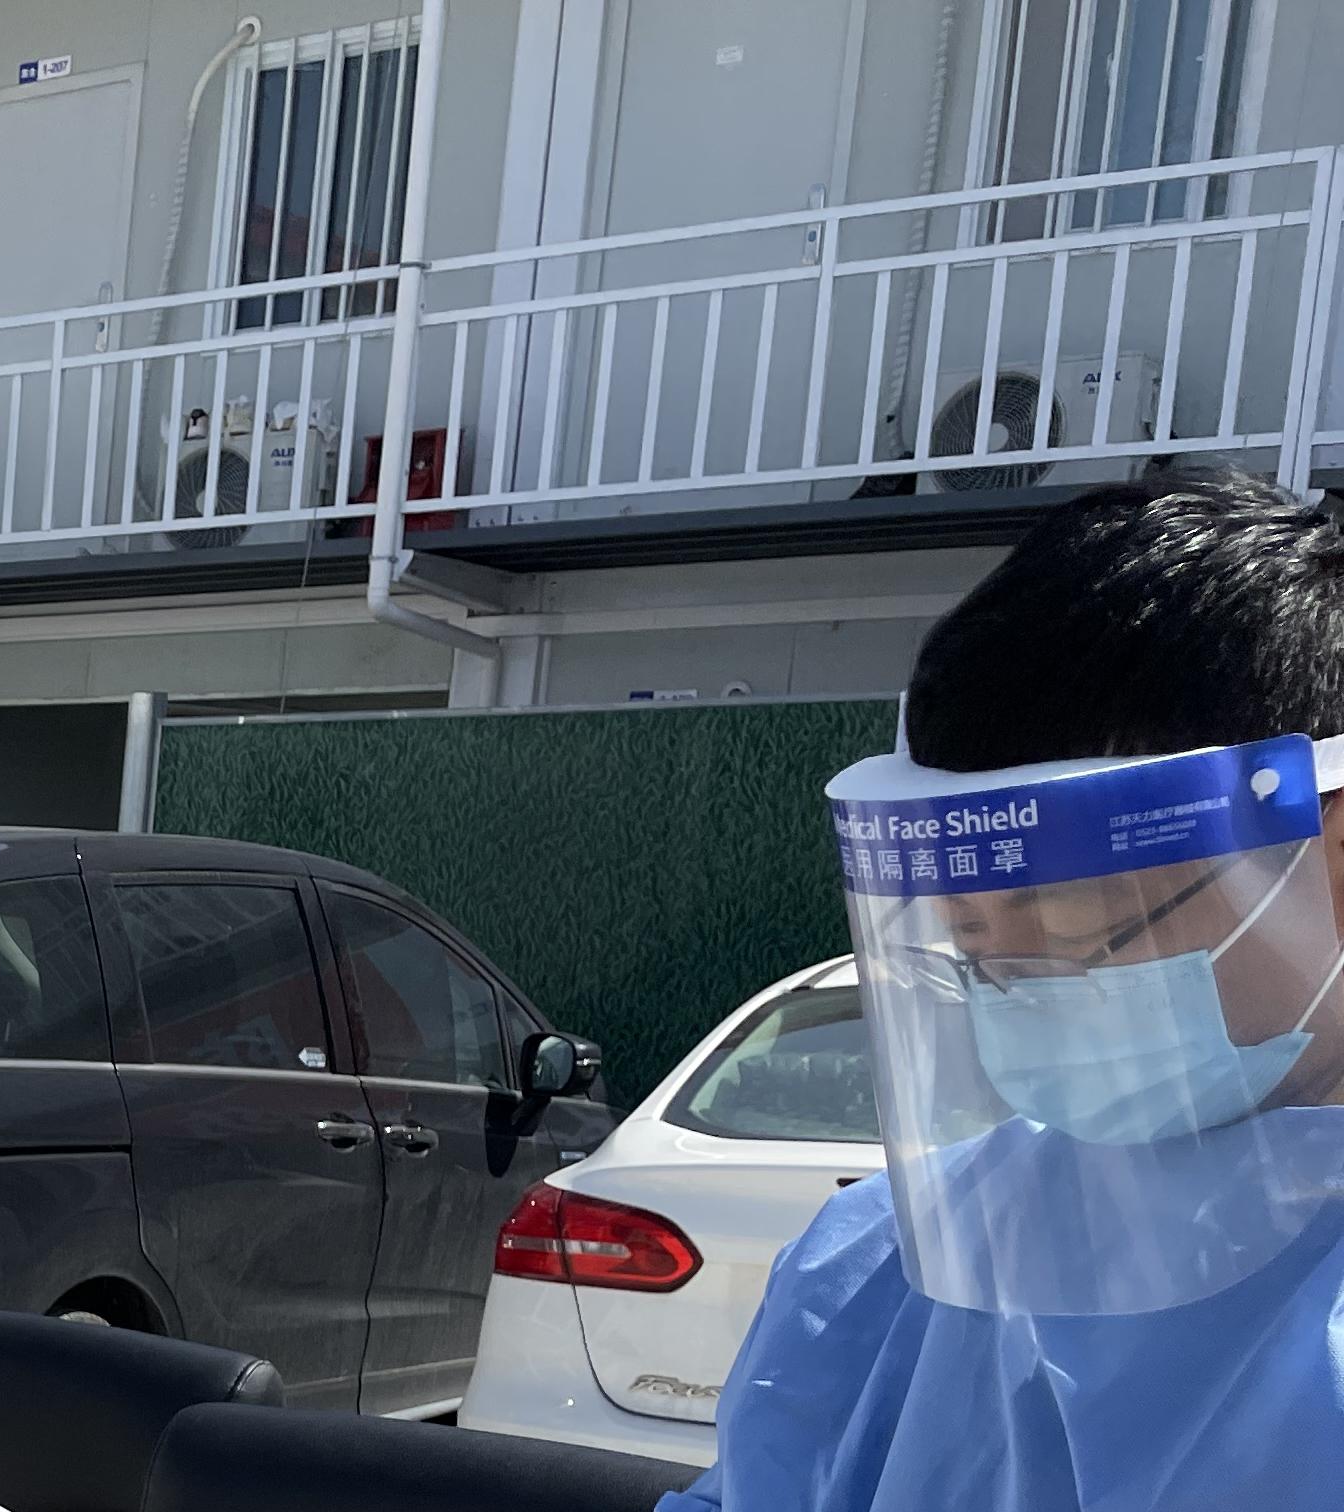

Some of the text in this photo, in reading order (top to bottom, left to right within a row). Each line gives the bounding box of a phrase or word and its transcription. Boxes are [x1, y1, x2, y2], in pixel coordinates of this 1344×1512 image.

[888, 814, 942, 841] Face
[944, 797, 1039, 838] Shield
[841, 837, 1028, 881] 医用隔离面罩
